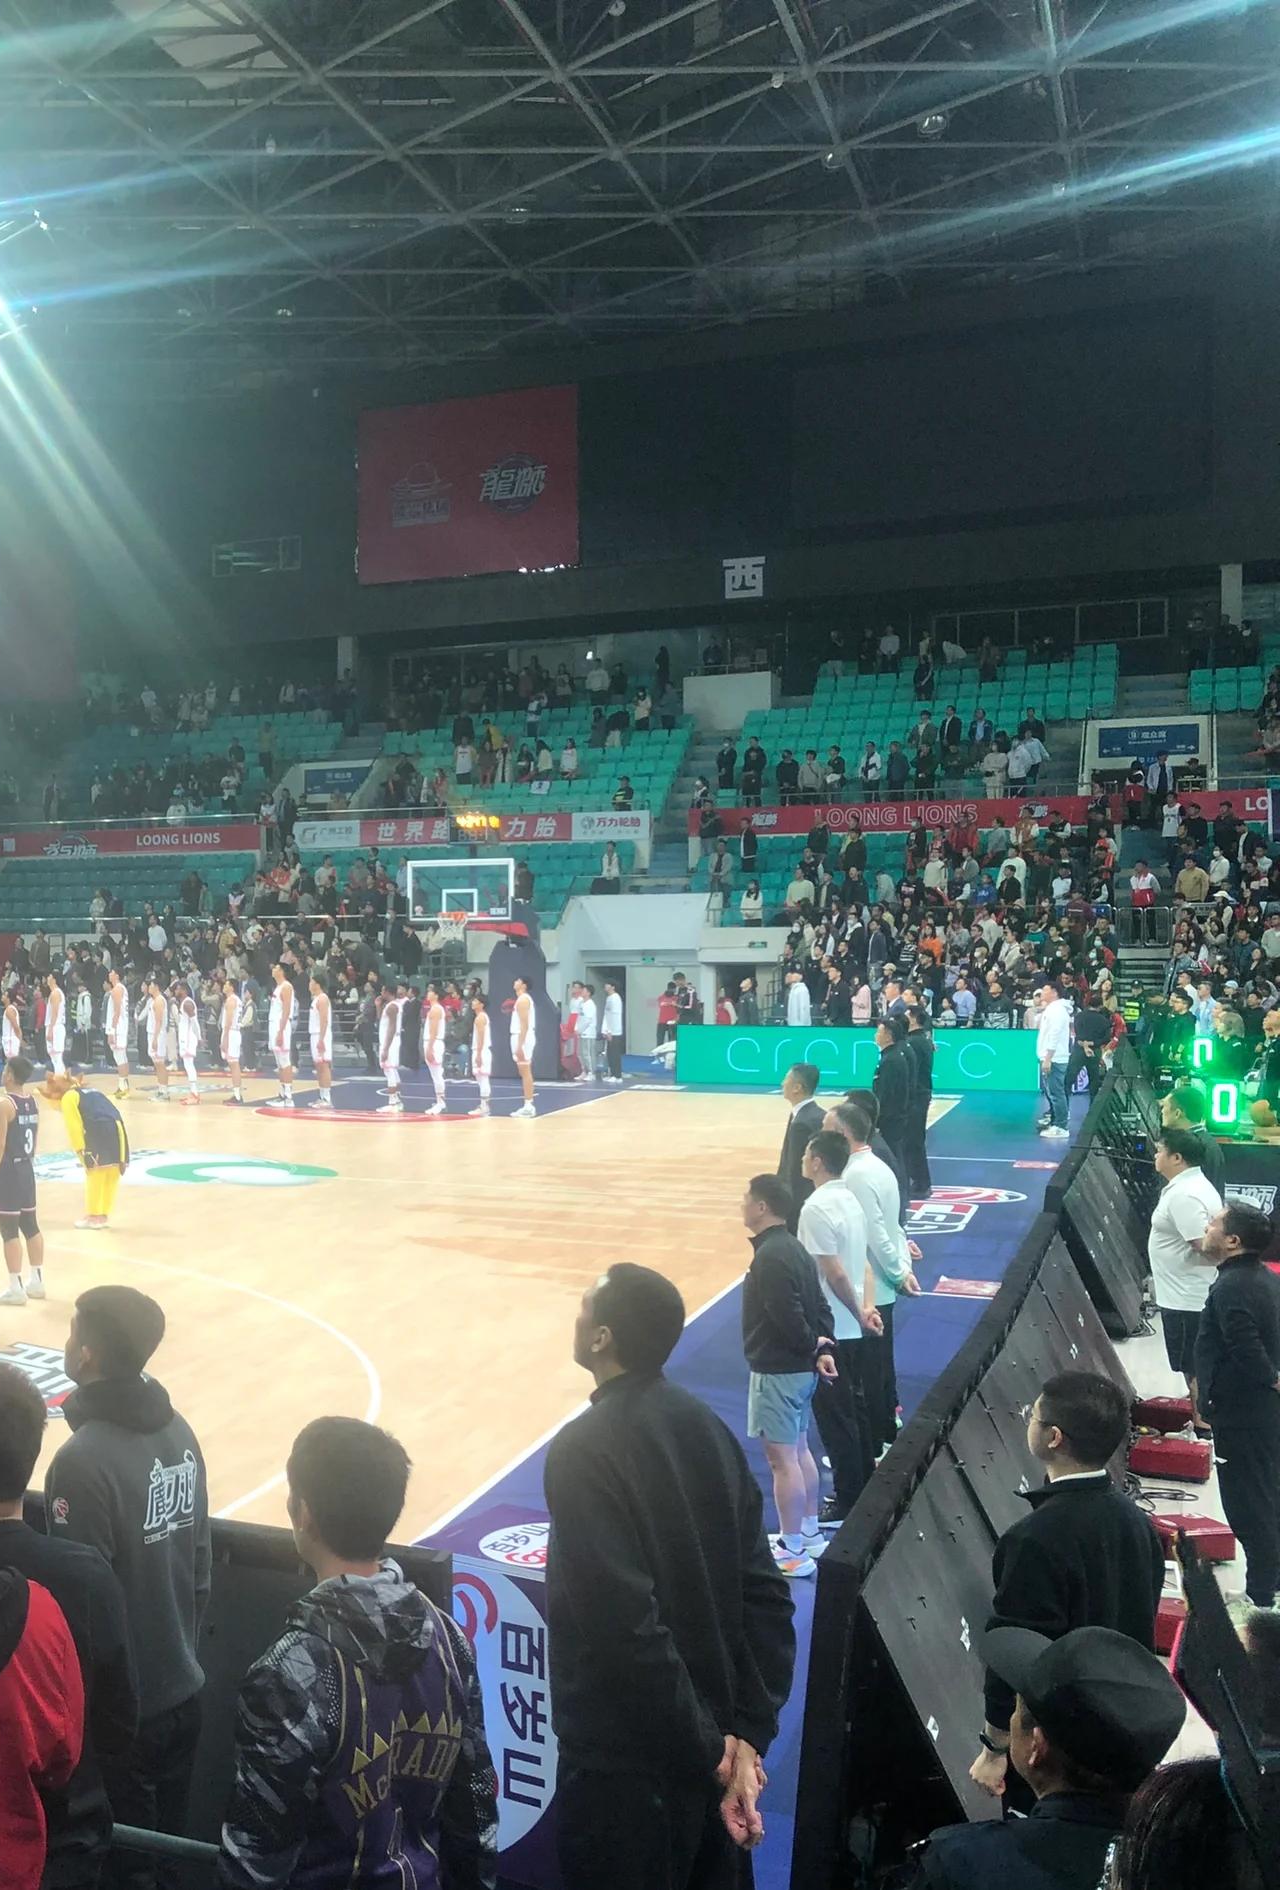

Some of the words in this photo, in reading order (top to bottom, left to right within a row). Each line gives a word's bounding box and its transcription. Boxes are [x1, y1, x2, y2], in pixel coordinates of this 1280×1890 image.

[723, 556, 766, 599] 西
[136, 833, 180, 846] LOONG
[183, 832, 221, 845] LIONS
[1212, 1082, 1238, 1123] 0
[24, 1128, 33, 1154] 3
[501, 1621, 547, 1809] 百岁山
